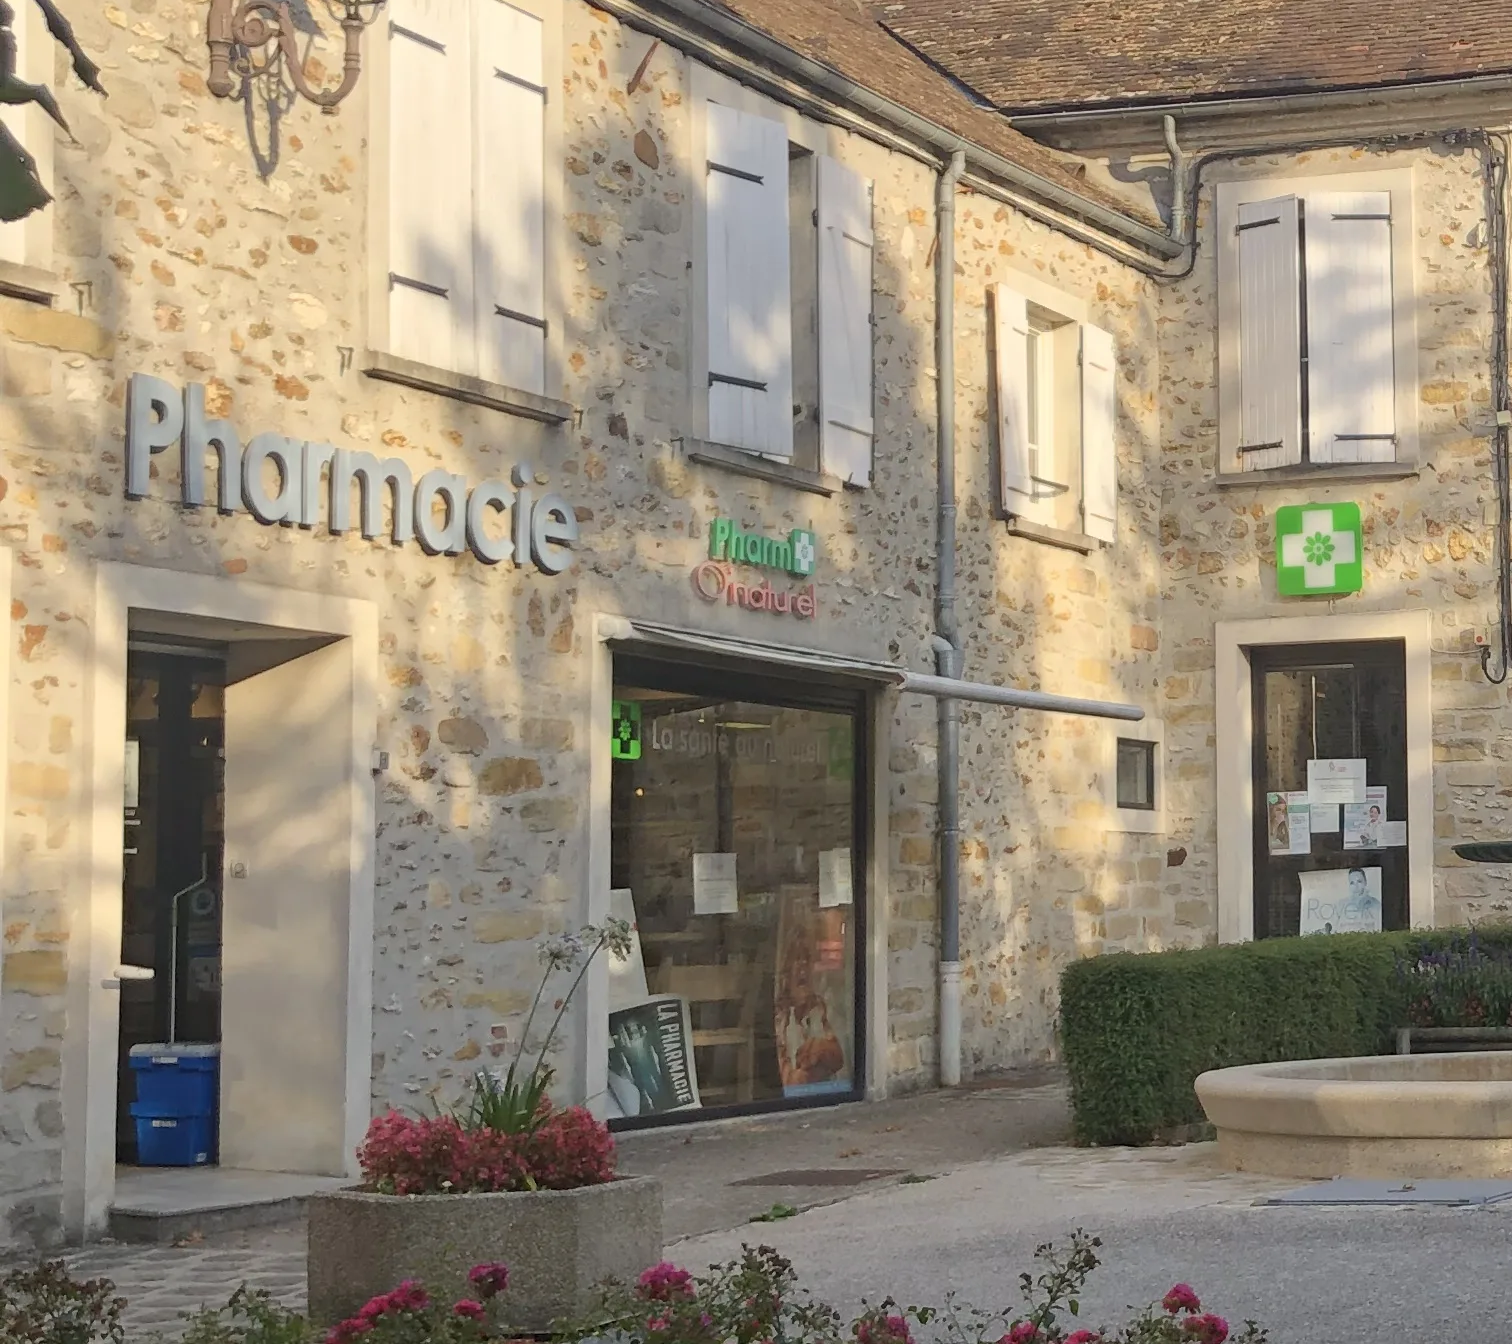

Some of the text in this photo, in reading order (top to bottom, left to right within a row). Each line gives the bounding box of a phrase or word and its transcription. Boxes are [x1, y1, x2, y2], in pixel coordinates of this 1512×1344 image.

[125, 372, 578, 575] Pharmacie
[709, 517, 792, 571] Pharm
[656, 1003, 692, 1102] LA PHARMACIE
